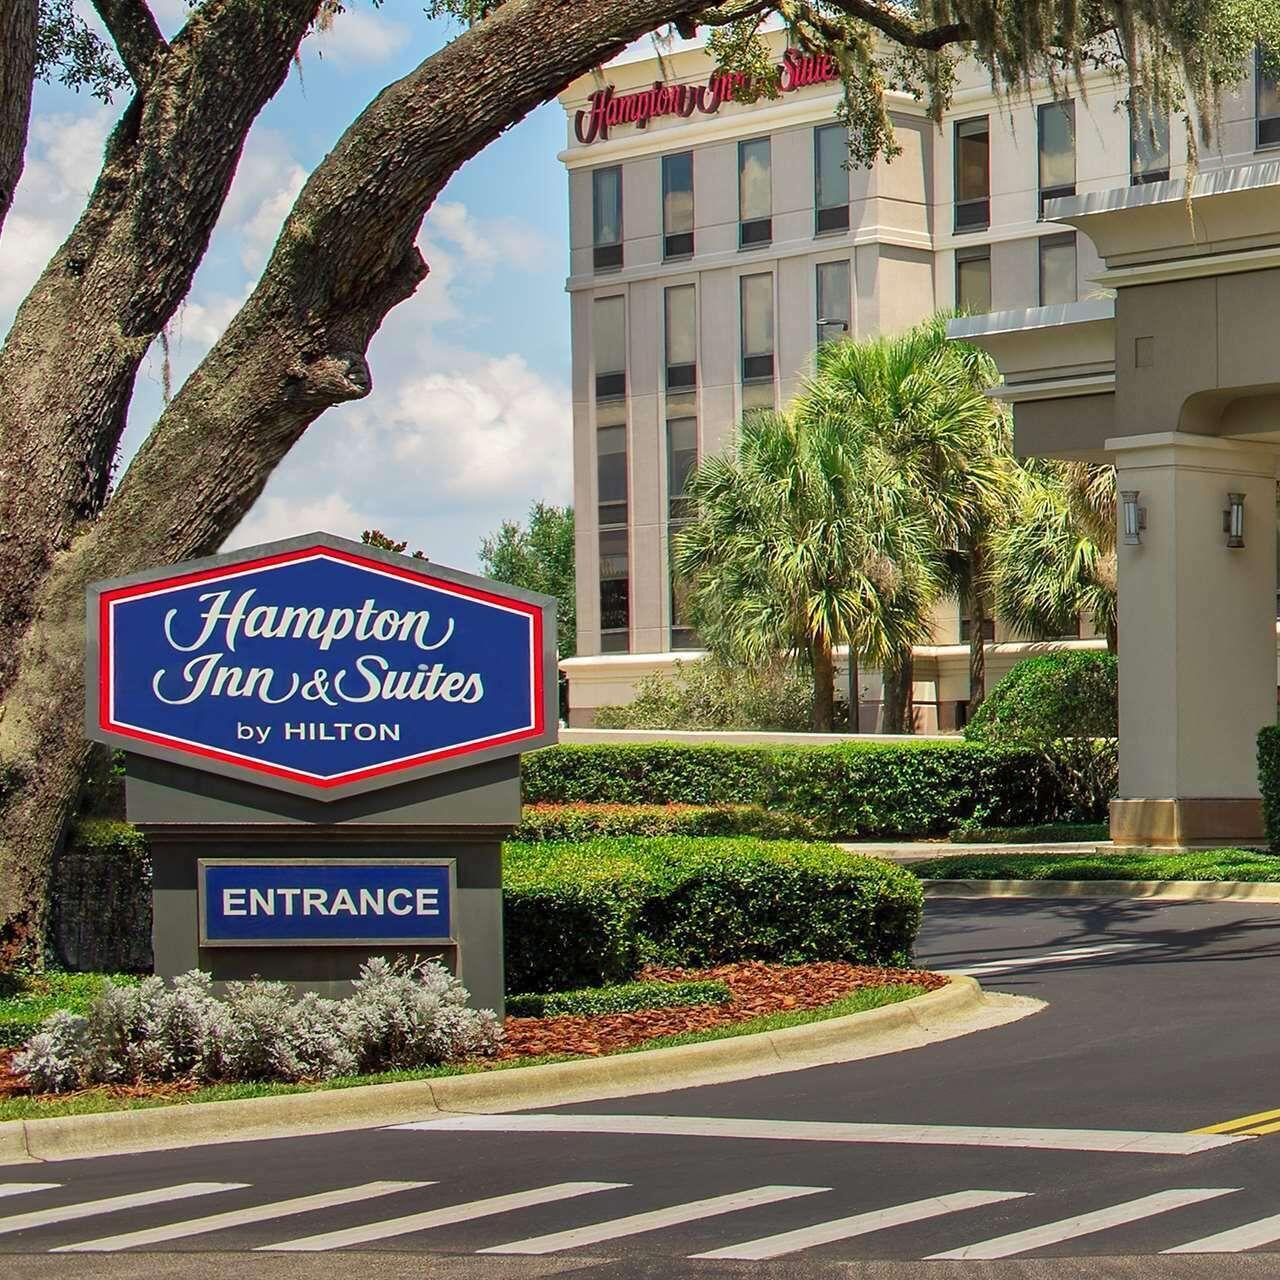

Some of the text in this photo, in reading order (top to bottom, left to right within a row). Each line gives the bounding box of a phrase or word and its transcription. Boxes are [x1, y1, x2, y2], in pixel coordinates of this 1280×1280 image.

[575, 81, 698, 144] Hampton
[776, 48, 840, 92] Suite
[164, 588, 455, 652] Hampton
[152, 653, 484, 706] Inn & Suites
[237, 721, 400, 744] by HILTON
[222, 888, 440, 916] ENTRANCE
